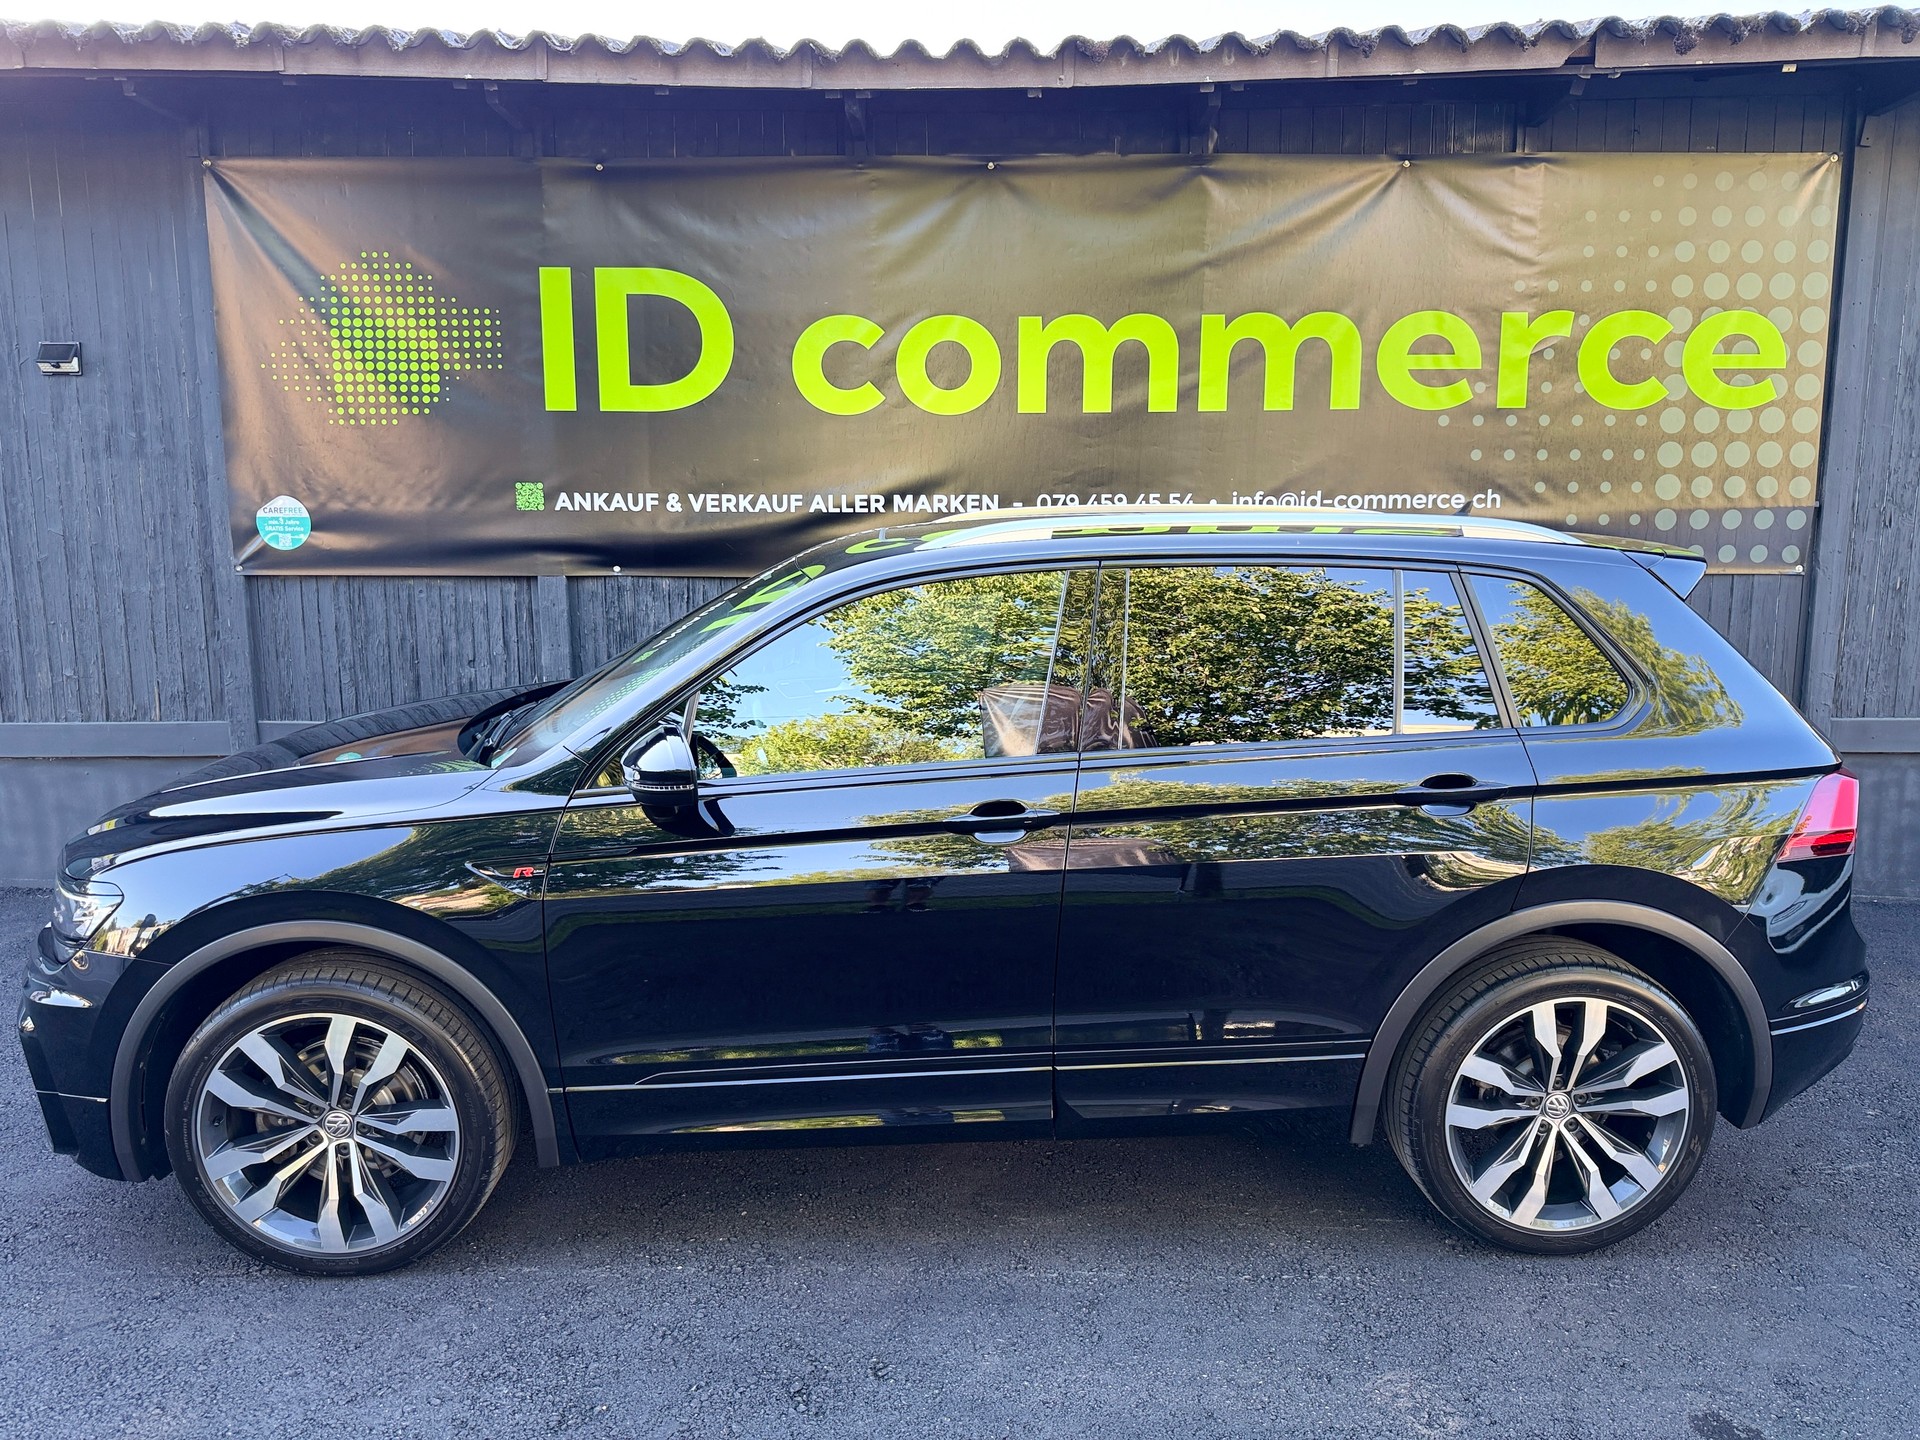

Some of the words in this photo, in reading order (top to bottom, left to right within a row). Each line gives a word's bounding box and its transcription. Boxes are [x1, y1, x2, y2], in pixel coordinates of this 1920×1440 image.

[538, 266, 734, 412] ID
[791, 309, 1787, 416] commerce
[262, 506, 303, 514] CAREFREE
[554, 492, 659, 513] ANKAUF
[666, 493, 683, 513] &
[688, 493, 803, 513] VERKAUF
[809, 493, 886, 513] ALLER
[892, 493, 999, 513] MARKEN
